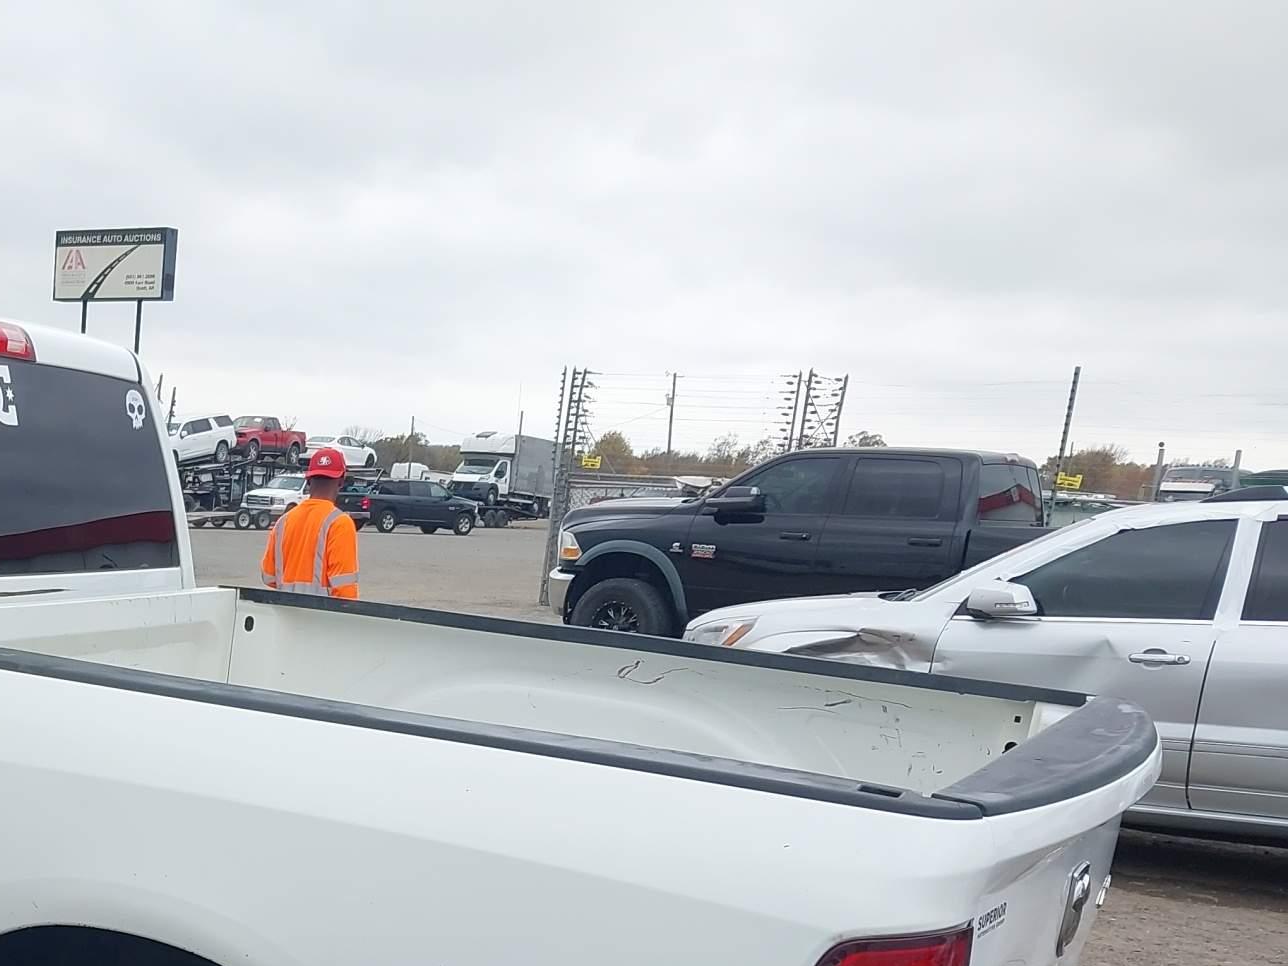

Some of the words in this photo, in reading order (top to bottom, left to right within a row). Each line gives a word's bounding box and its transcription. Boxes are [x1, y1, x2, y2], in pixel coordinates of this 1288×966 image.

[60, 235, 102, 245] INSURANCE
[103, 235, 122, 243] AUTO
[123, 233, 161, 242] AUCTIONS
[977, 902, 1007, 931] SUPERIOR
